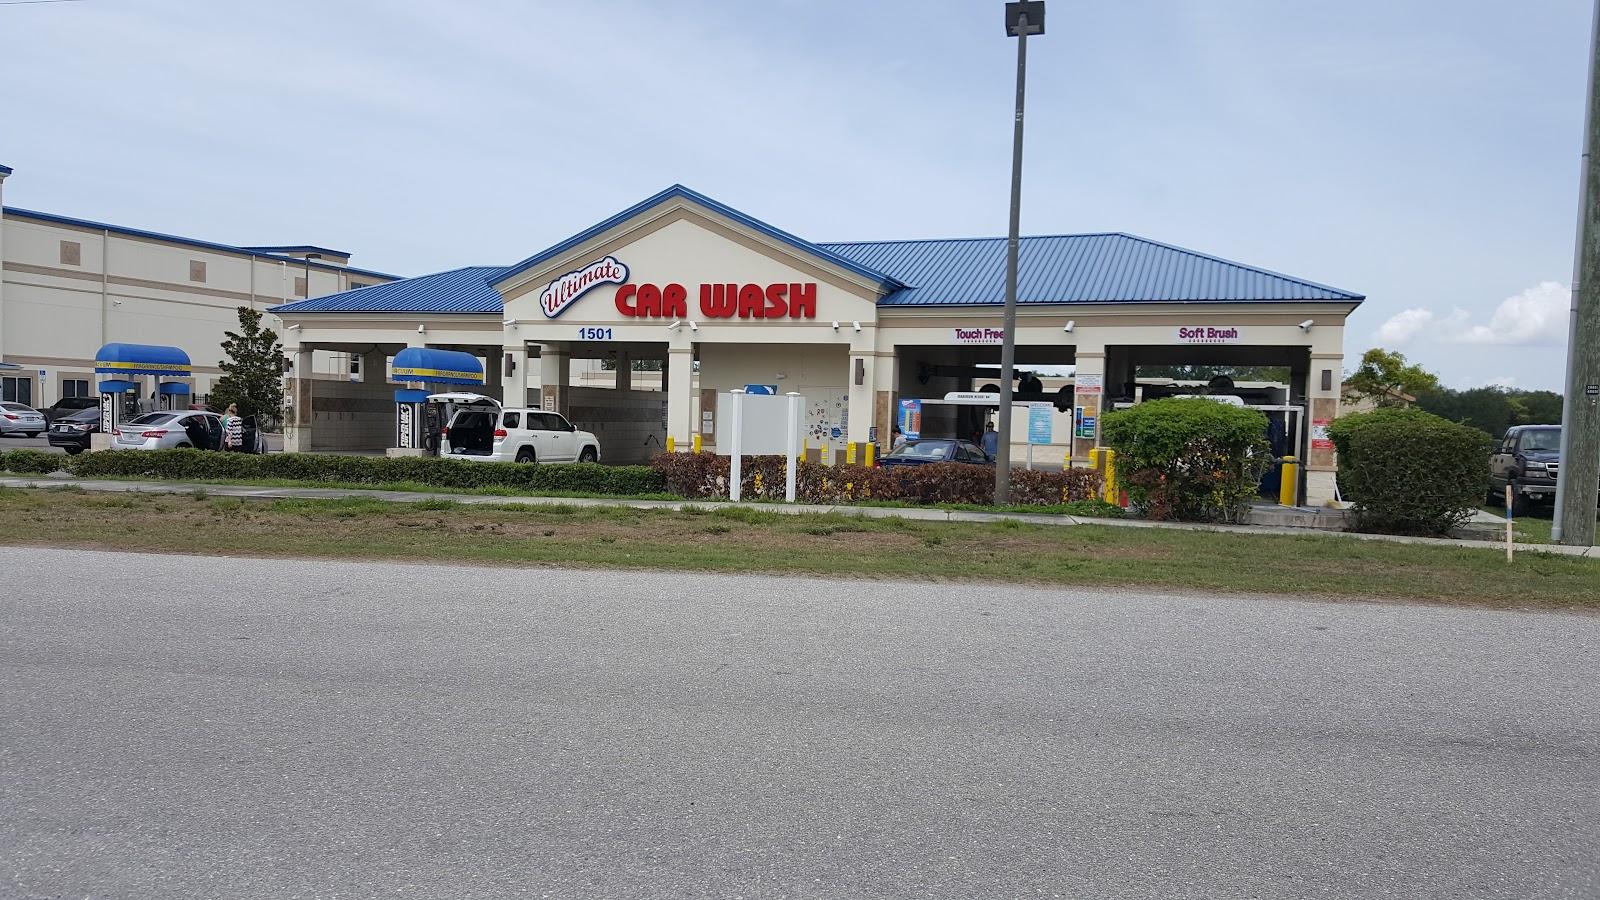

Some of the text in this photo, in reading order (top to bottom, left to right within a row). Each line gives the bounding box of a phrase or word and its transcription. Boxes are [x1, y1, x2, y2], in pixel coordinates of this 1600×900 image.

[544, 261, 622, 313] Ultimate
[615, 283, 817, 319] CAR WASH
[579, 327, 612, 340] 1501
[955, 328, 1004, 339] Touch Free
[1179, 327, 1238, 339] Soft Brush
